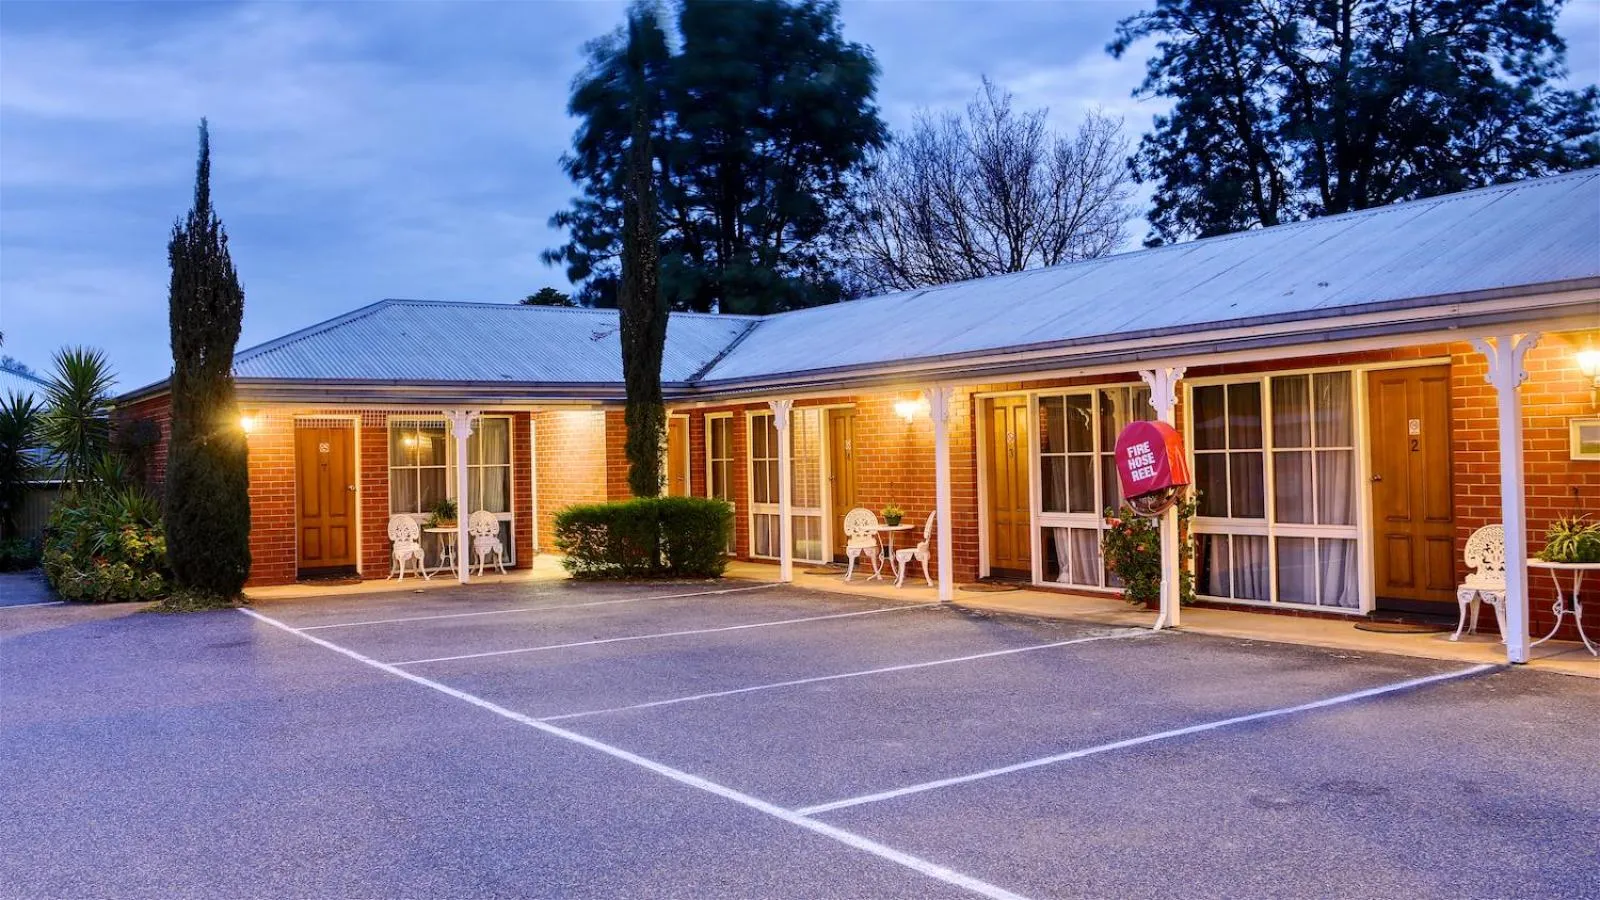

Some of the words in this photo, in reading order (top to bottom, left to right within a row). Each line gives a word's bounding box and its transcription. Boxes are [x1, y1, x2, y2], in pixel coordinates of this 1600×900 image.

[1127, 441, 1151, 458] FIRE
[1411, 439, 1420, 452] 2
[1128, 452, 1155, 470] HOSE
[1131, 465, 1157, 482] REEL
